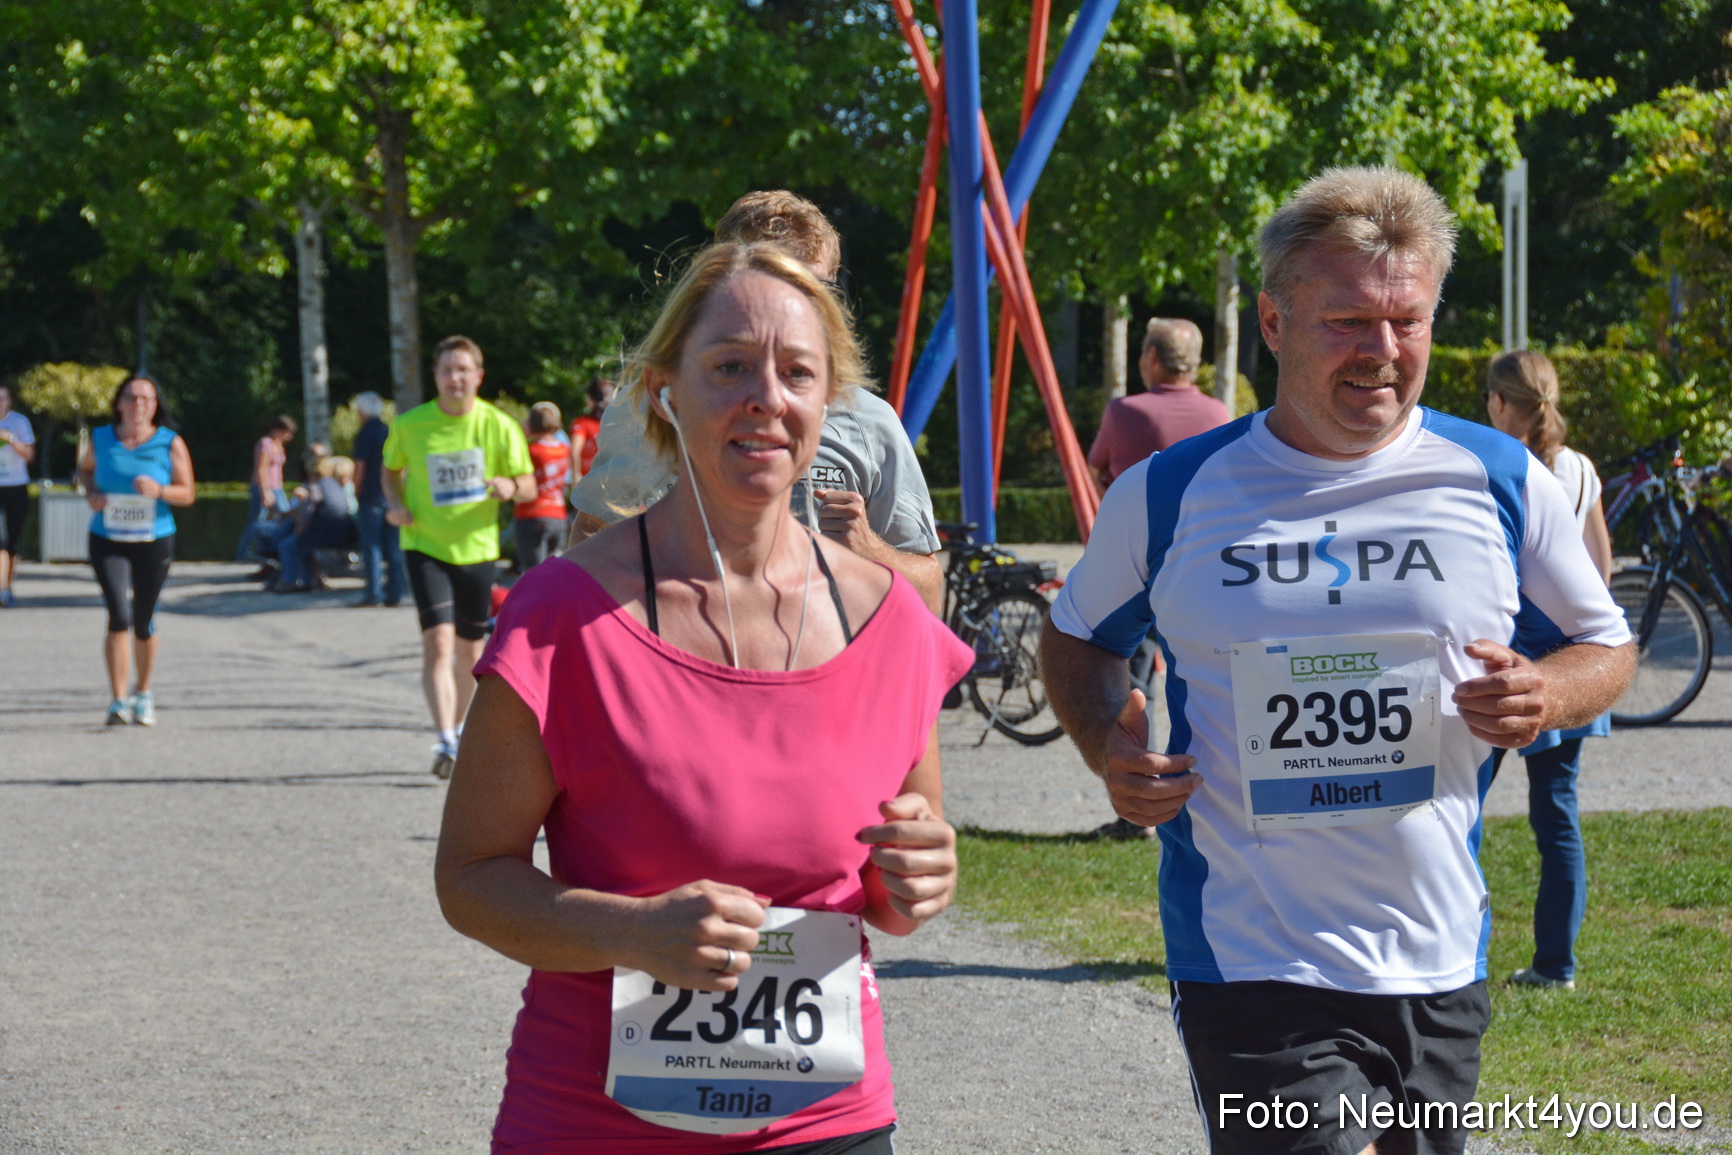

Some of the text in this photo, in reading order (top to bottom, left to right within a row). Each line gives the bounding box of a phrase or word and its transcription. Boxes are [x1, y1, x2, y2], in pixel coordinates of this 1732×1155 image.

[436, 463, 476, 484] 2107
[1220, 521, 1444, 605] SUSPA
[1291, 652, 1380, 675] BOCK
[1292, 675, 1319, 683] inspired
[1266, 686, 1412, 750] 2395
[1250, 739, 1259, 751] D
[1283, 754, 1387, 770] PARTL Neumarkt
[1309, 780, 1382, 807] Albert
[650, 976, 823, 1046] 2346
[625, 1027, 635, 1040] D
[665, 1055, 791, 1072] PARTL Neumarkt
[696, 1086, 772, 1117] Tanja
